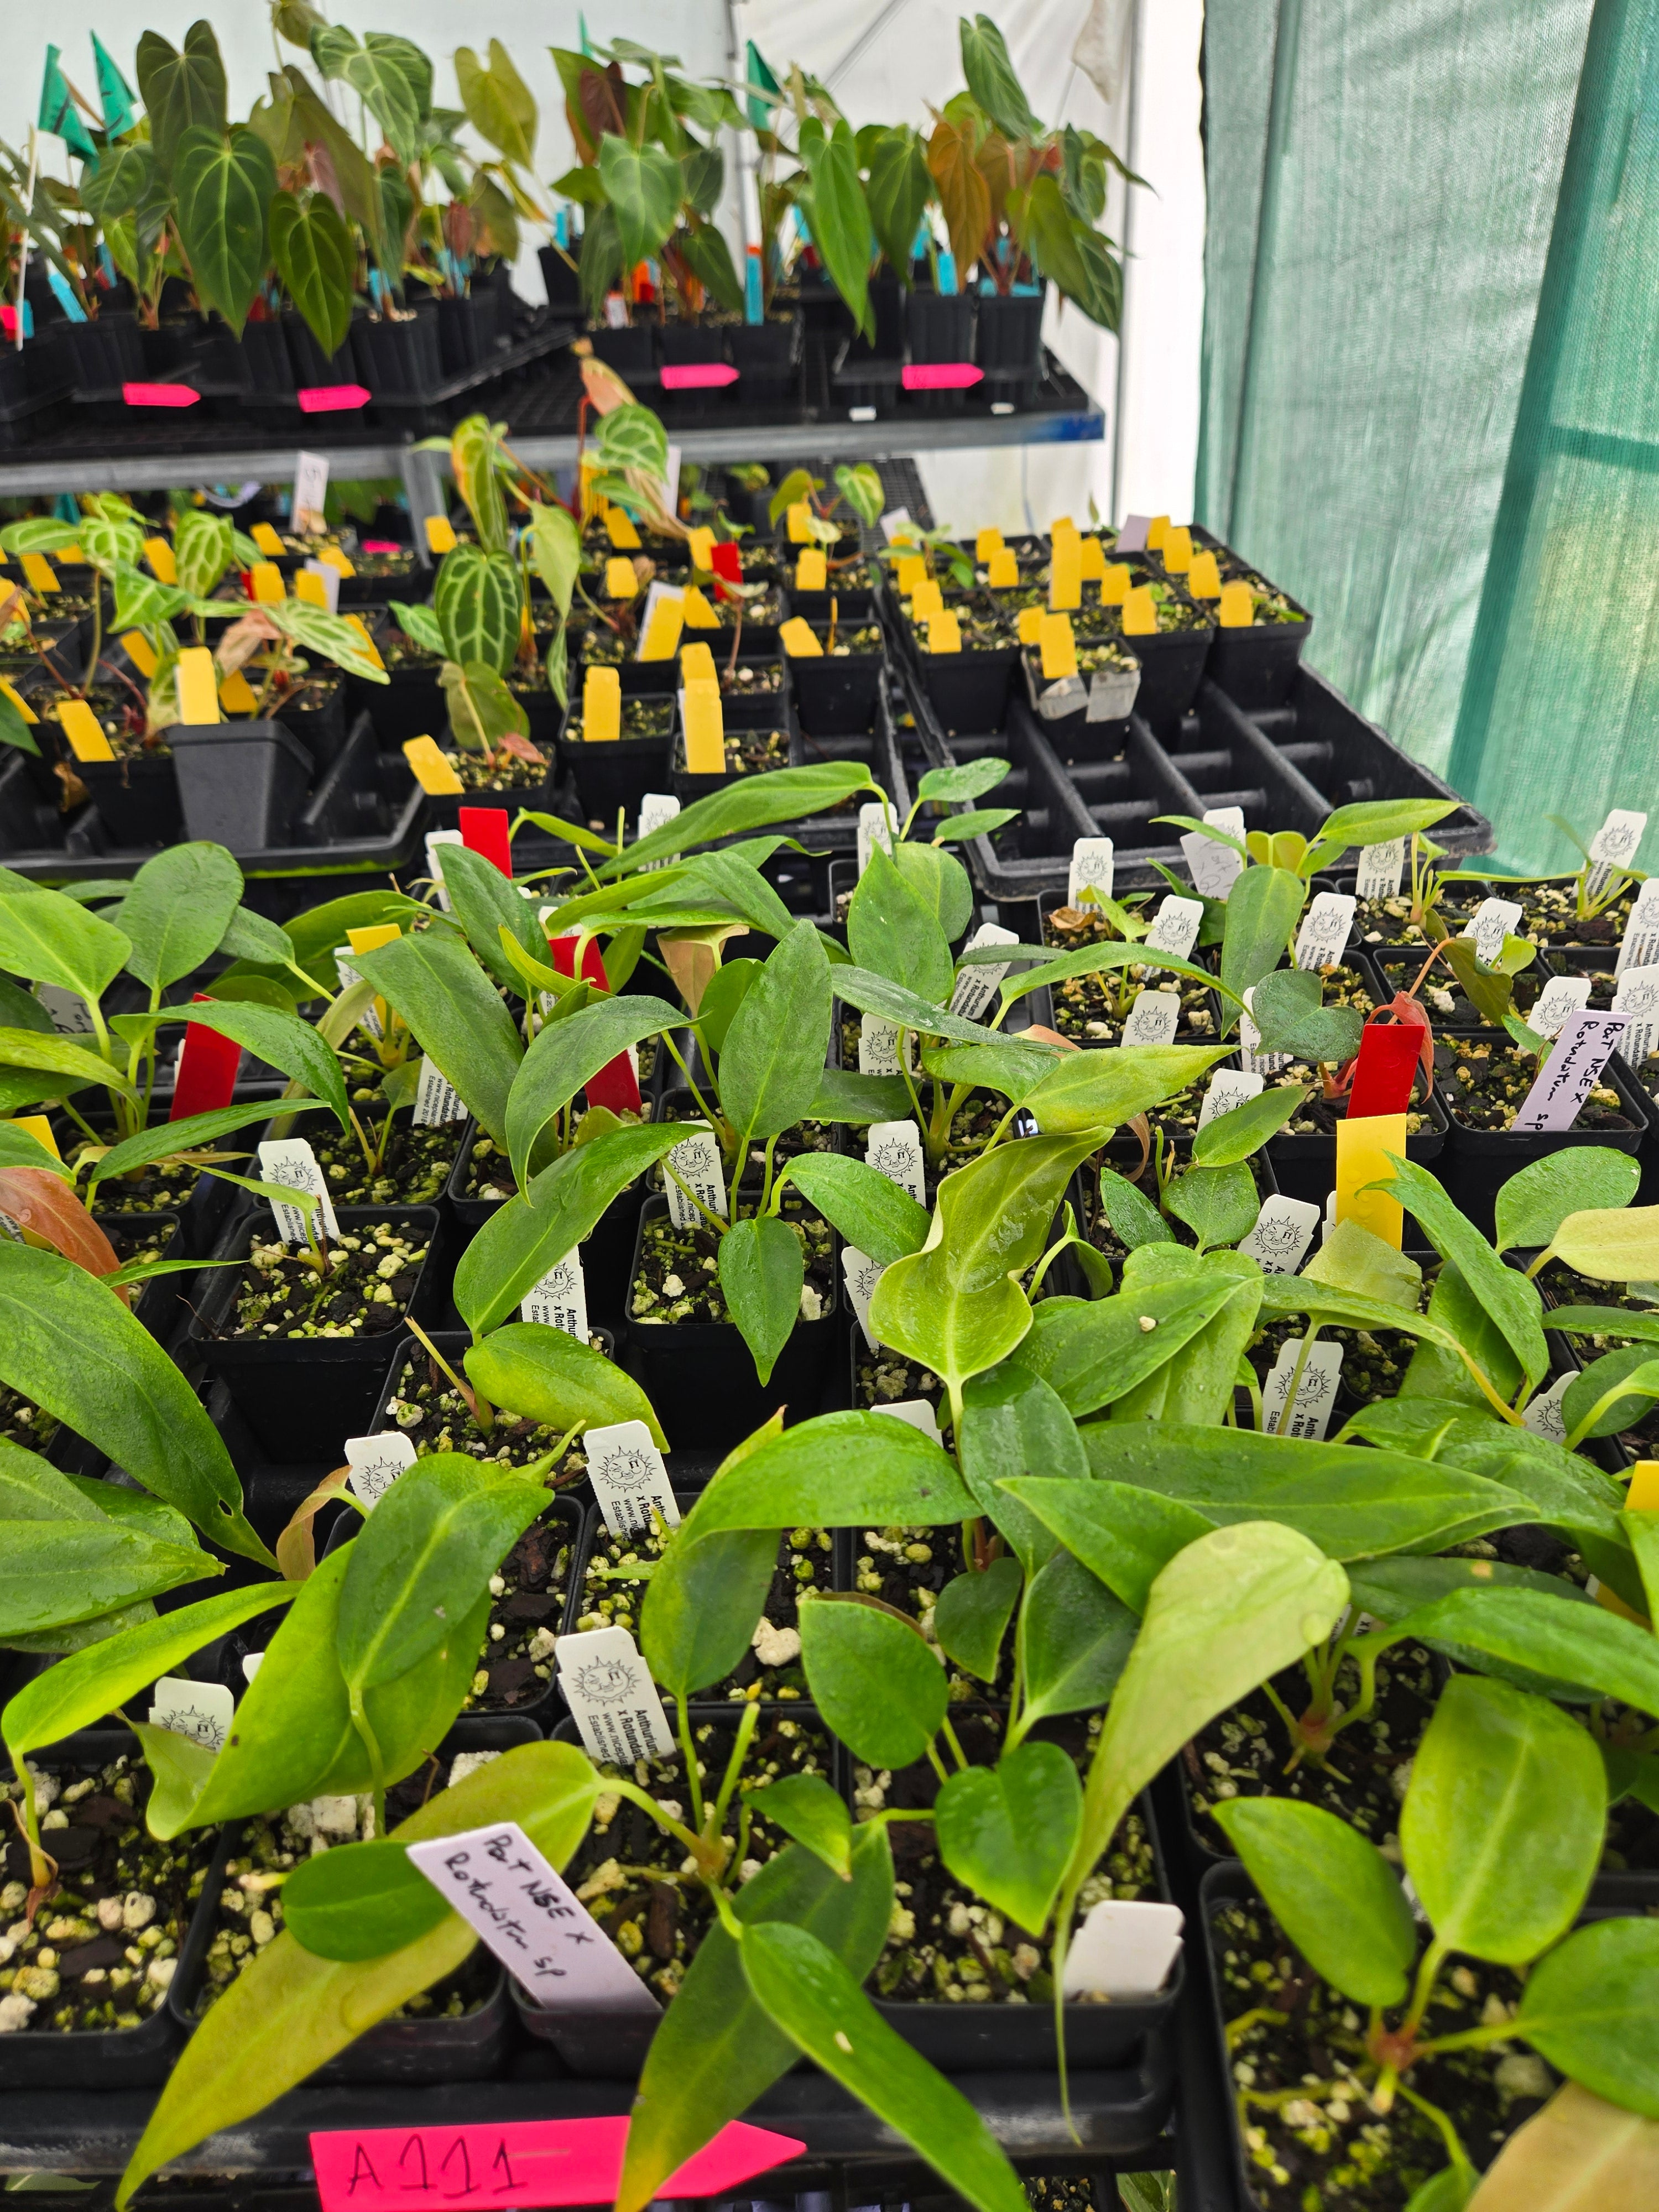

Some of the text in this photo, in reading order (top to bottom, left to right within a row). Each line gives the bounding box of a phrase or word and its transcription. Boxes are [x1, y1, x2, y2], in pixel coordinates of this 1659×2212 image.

[957, 984, 980, 1016] Rotundatu
[706, 1185, 718, 1213] Anthuri
[566, 1308, 578, 1338] Anthur
[1266, 1411, 1280, 1433] Establ
